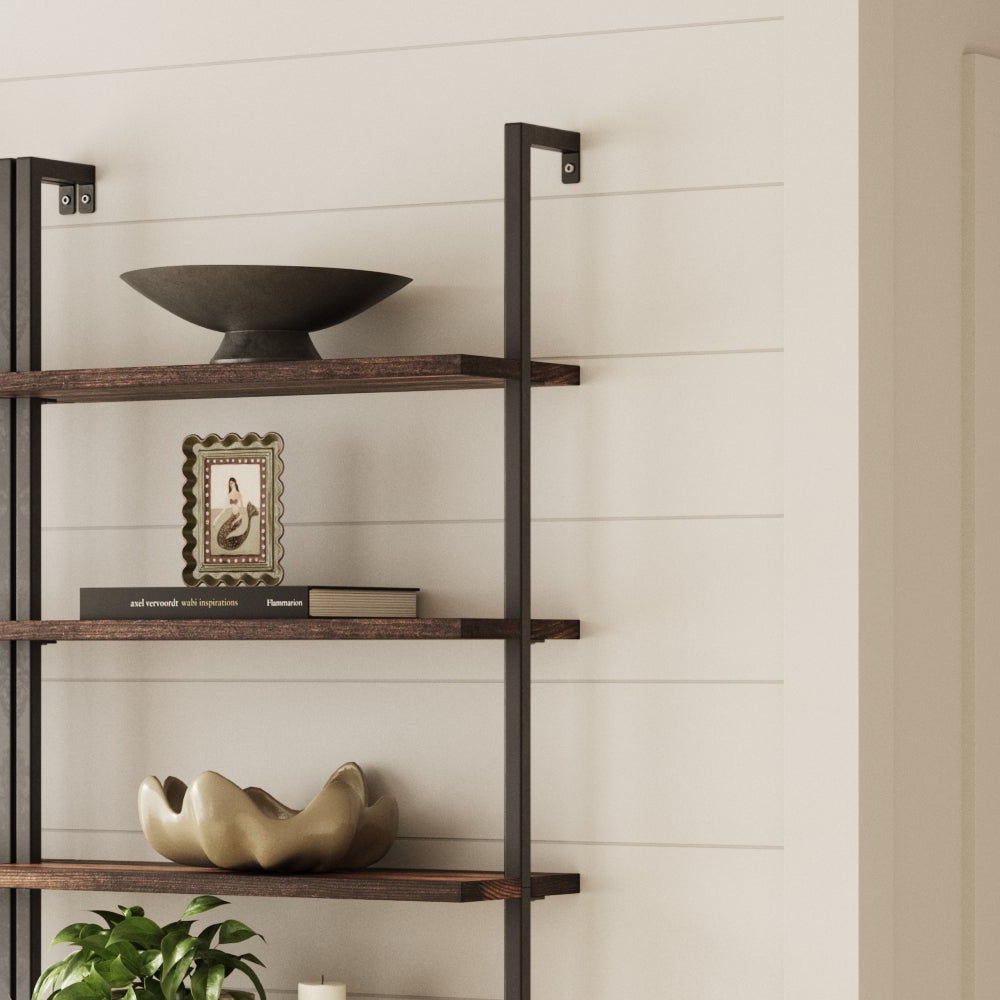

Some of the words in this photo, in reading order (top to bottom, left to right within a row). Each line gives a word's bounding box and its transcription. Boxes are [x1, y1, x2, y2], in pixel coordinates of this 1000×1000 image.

[130, 598, 145, 607] axel
[146, 599, 179, 608] vervoordt
[181, 598, 198, 607] wabi
[199, 598, 239, 609] inspirations
[267, 598, 303, 607] Flammarion
